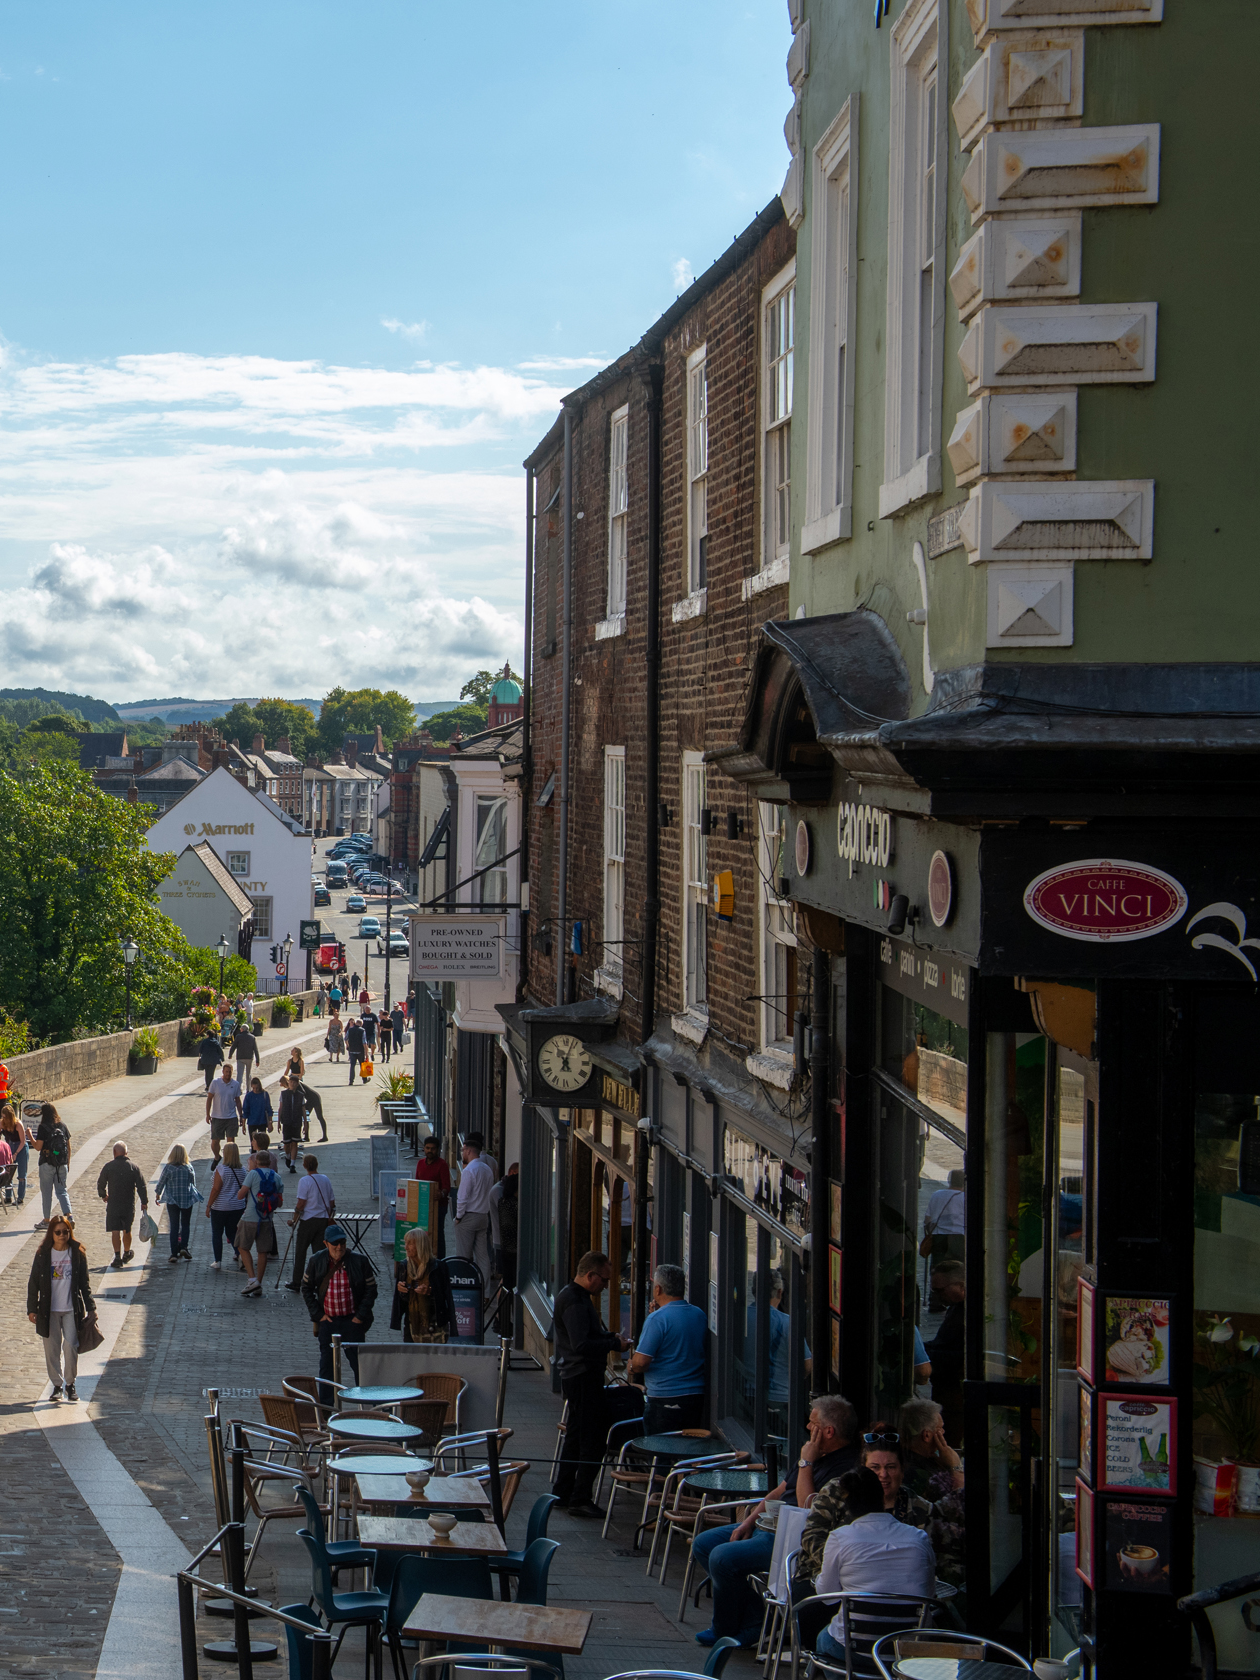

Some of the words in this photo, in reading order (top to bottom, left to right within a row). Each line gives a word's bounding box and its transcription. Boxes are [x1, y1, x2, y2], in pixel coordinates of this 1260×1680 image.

[197, 822, 255, 837] Marriott
[1087, 879, 1126, 890] CAFFE
[1057, 893, 1154, 918] VINCI
[455, 940, 497, 948] WATCHES
[900, 949, 915, 977] panini
[923, 955, 938, 989] pizza
[1120, 1405, 1156, 1413] capriccio
[1106, 1414, 1131, 1422] Peroni
[1106, 1425, 1153, 1435] Rekorderlig
[1106, 1434, 1136, 1443] Corona
[1106, 1454, 1130, 1463] COLD
[1106, 1465, 1133, 1473] BEERS
[1122, 1512, 1162, 1522] COFFEE
